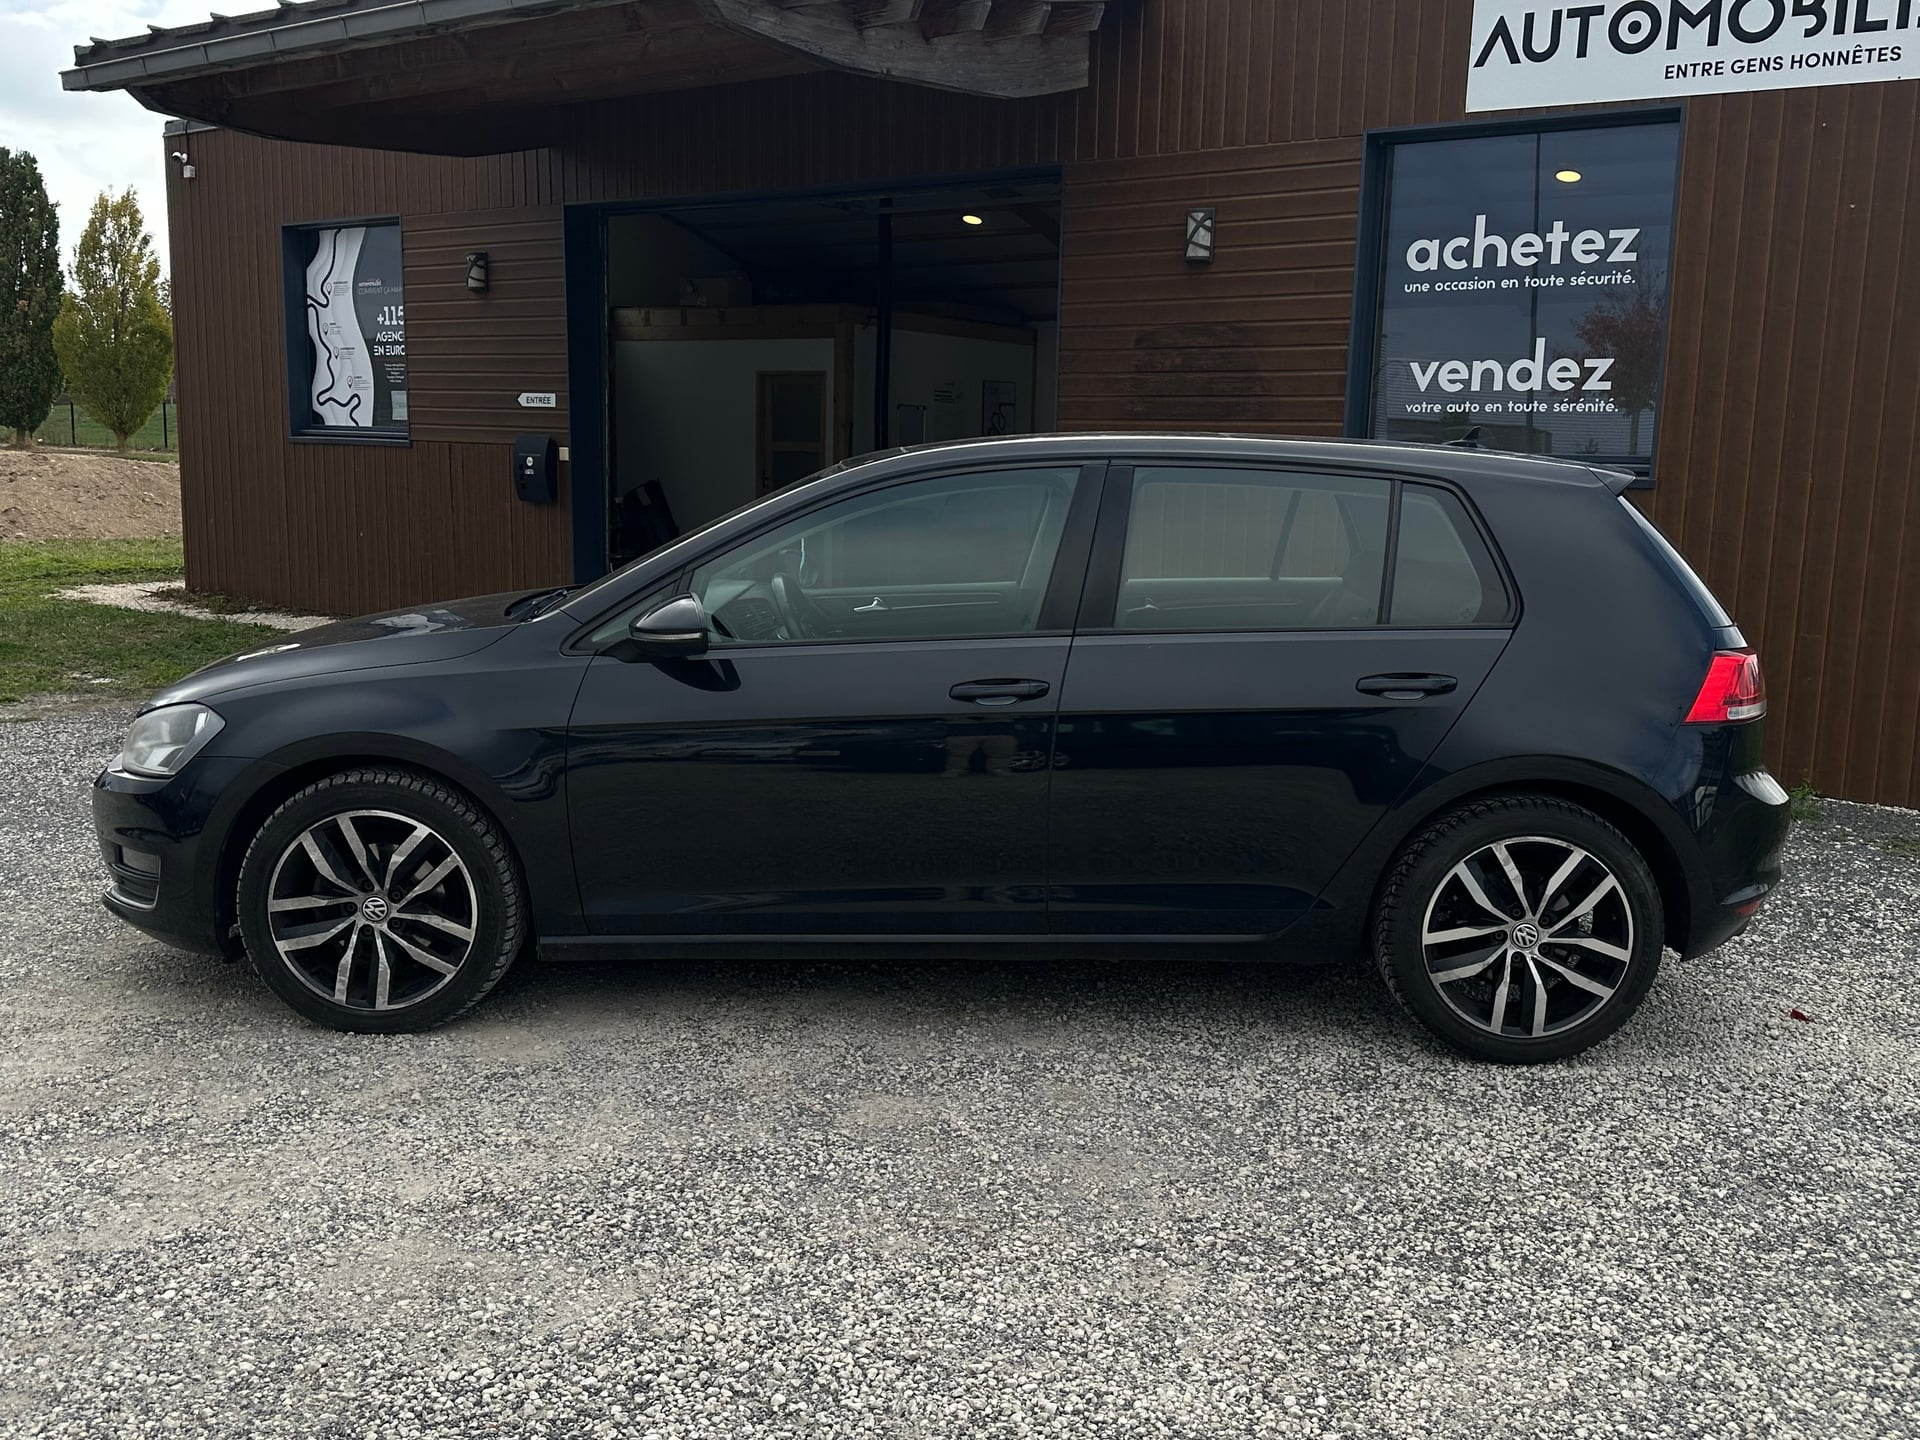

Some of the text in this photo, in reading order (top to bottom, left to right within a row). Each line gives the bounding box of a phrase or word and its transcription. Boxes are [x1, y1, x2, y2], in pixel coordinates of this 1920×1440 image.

[1473, 0, 1920, 68] AUTOMOBILI
[1664, 44, 1902, 80] ENTRE GENS HONNÊTES
[1406, 214, 1641, 272] achetez
[1404, 269, 1637, 293] une occasion en toute sécurité.
[376, 331, 404, 342] AGENC
[374, 345, 385, 356] EN
[1409, 337, 1615, 393] vendez
[526, 395, 551, 405] ENTRÉE
[1405, 398, 1619, 414] votre auto en toute sérénité.
